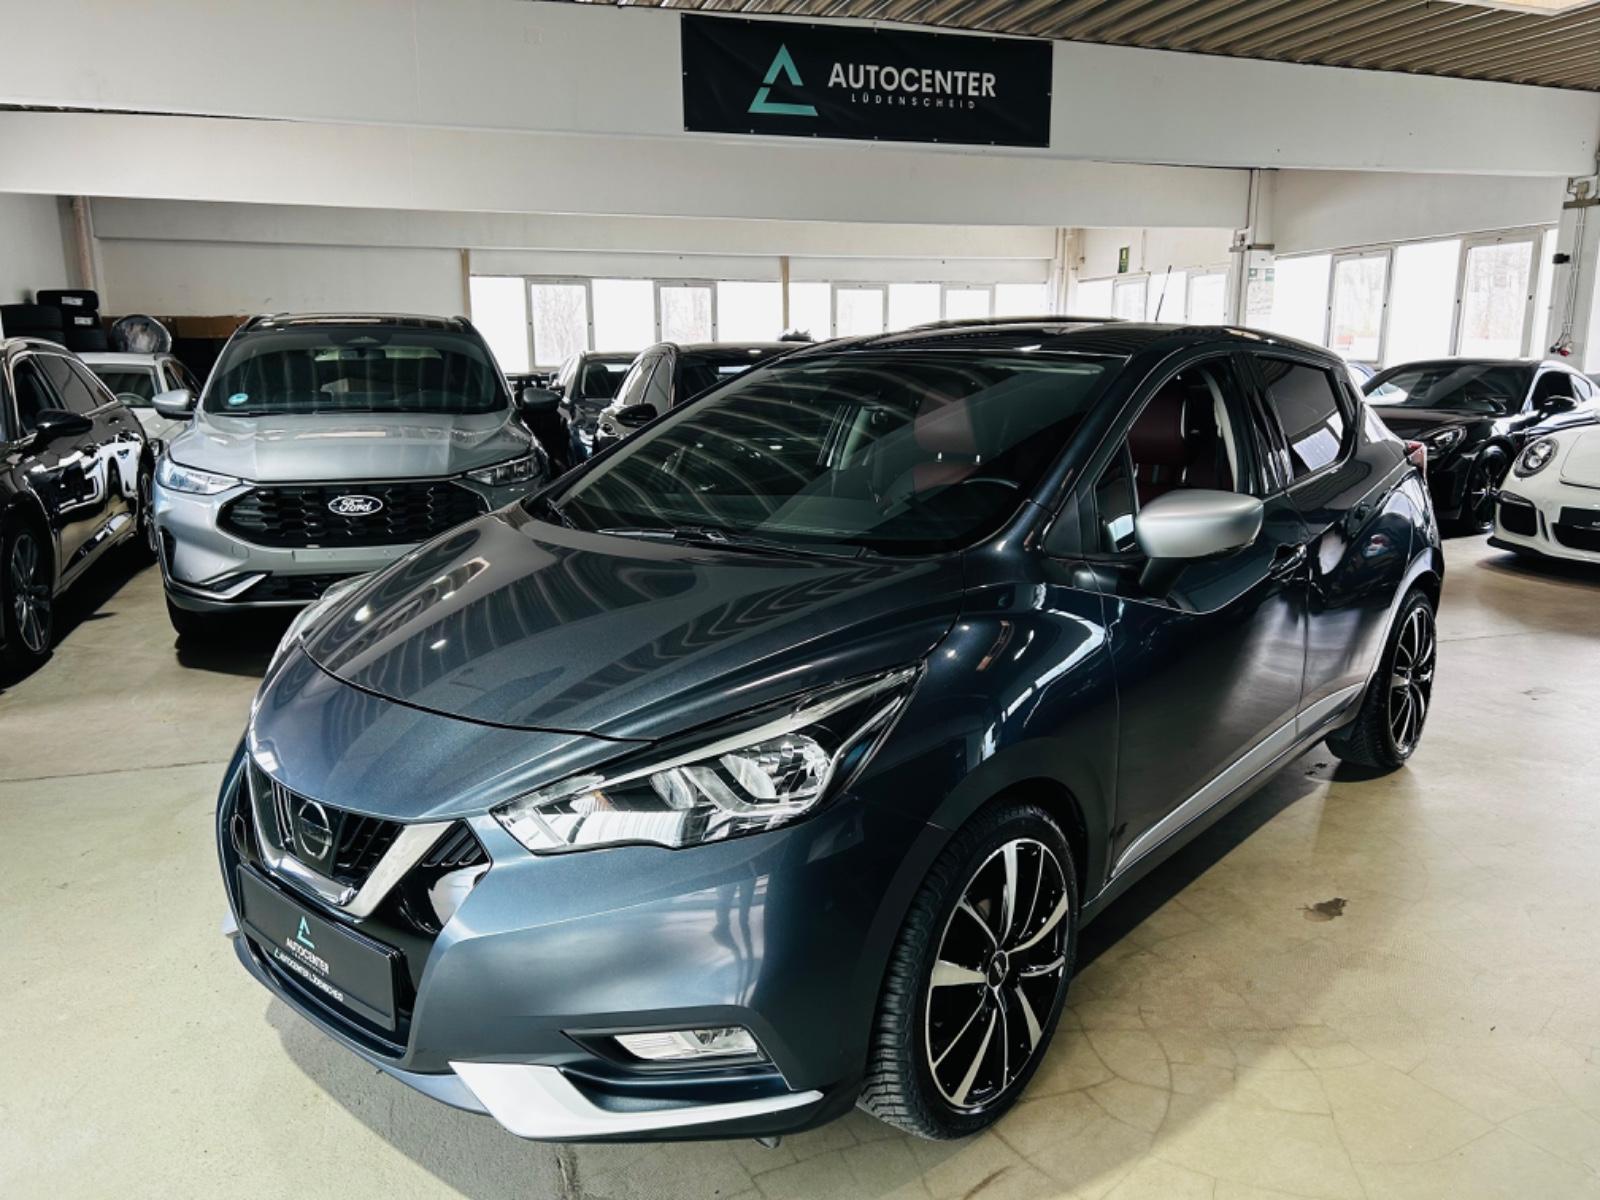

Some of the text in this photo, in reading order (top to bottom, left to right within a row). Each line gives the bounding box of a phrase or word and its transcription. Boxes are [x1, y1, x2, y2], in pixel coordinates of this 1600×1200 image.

[828, 62, 997, 98] AUTOCENTER
[851, 92, 976, 109] LÜDENSCHEID
[339, 498, 373, 512] Ford
